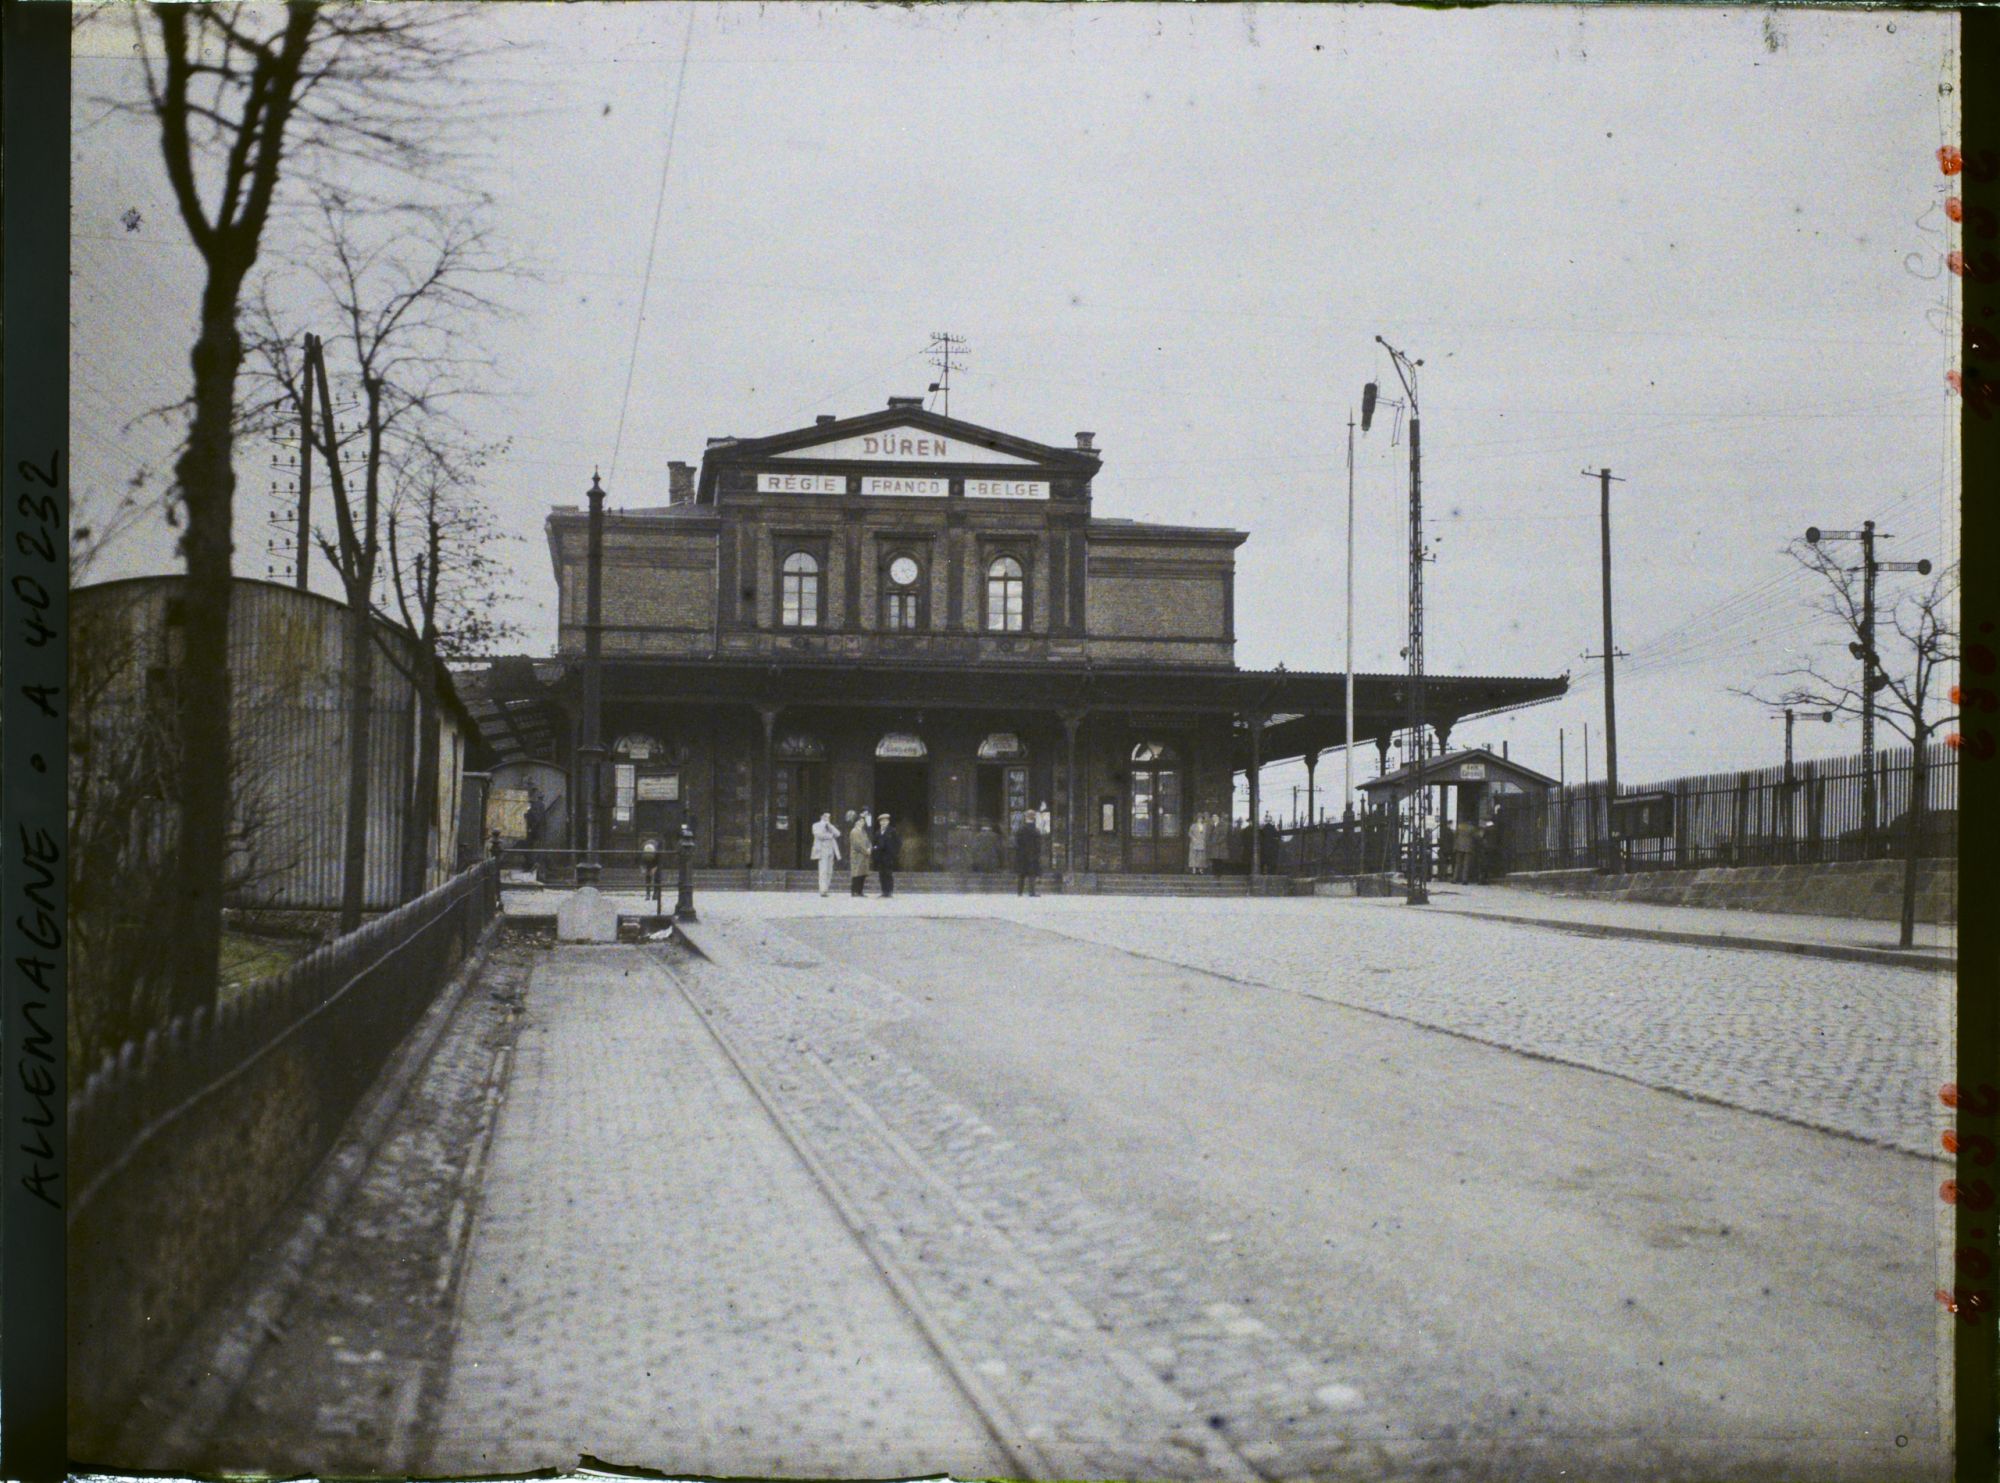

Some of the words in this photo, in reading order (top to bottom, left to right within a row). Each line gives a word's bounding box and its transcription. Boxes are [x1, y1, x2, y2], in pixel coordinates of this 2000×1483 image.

[863, 434, 947, 457] DÜREN
[768, 474, 836, 492] RÉGIE
[871, 481, 940, 494] FRANCO
[15, 821, 62, 1209] ALLEMAGNE
